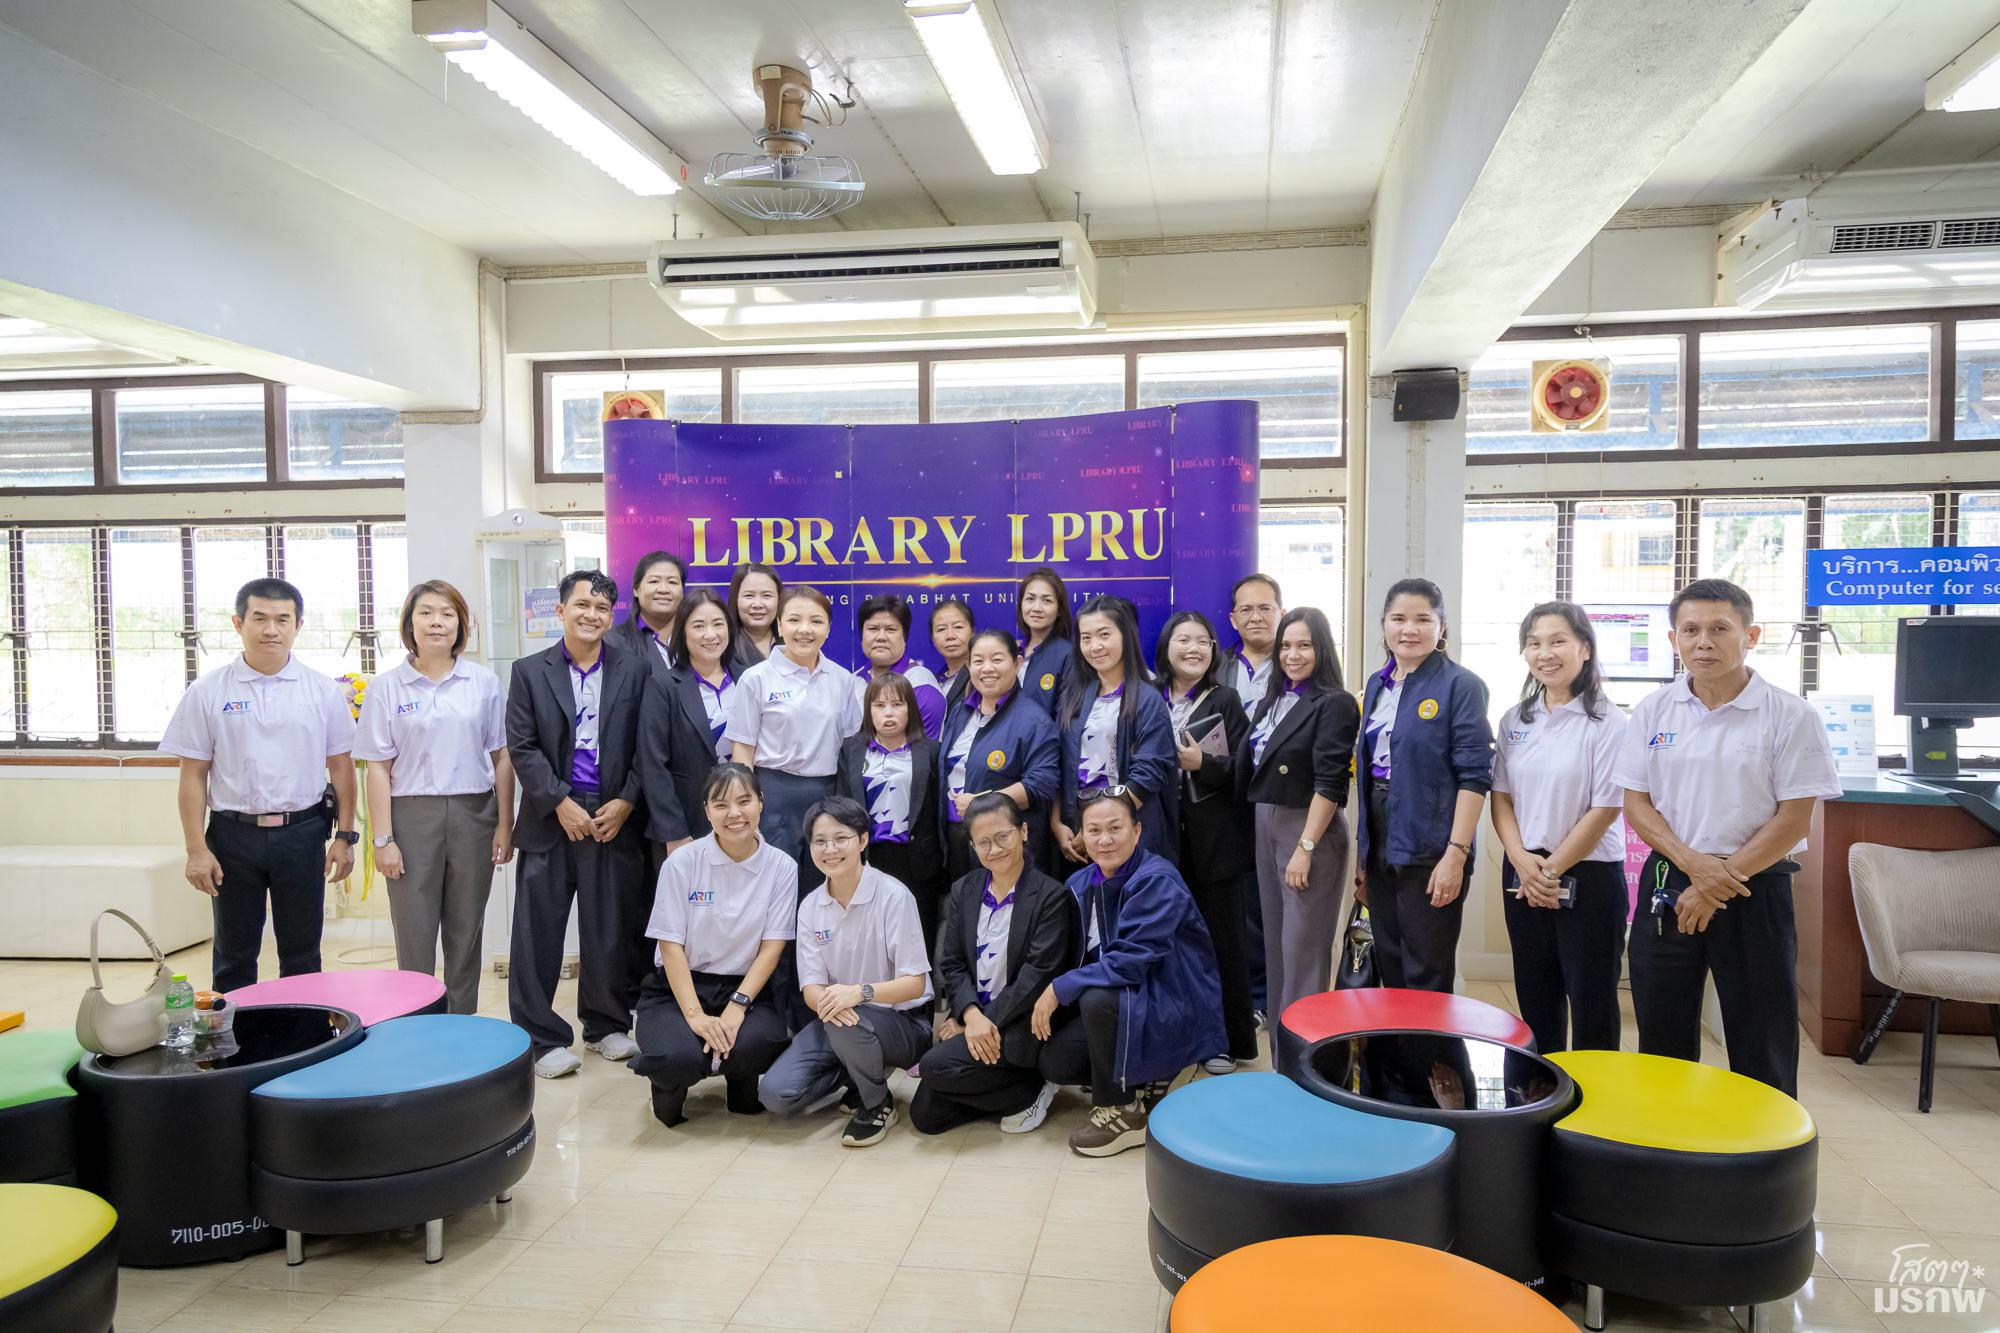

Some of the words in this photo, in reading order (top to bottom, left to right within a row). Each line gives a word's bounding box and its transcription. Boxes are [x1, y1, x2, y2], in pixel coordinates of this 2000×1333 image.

[1080, 466, 1117, 478] LIBRARY
[704, 476, 729, 485] LPRU
[687, 515, 977, 567] LIBRARY
[1007, 507, 1167, 564] LPRU
[1826, 580, 1933, 599] Computer
[1943, 579, 1974, 595] for
[768, 690, 792, 703] ARIT
[222, 700, 251, 712] ARIT
[397, 700, 422, 717] ARIT
[1507, 731, 1530, 741] ARIT
[688, 891, 715, 903] ARIT
[814, 929, 831, 942] RIT
